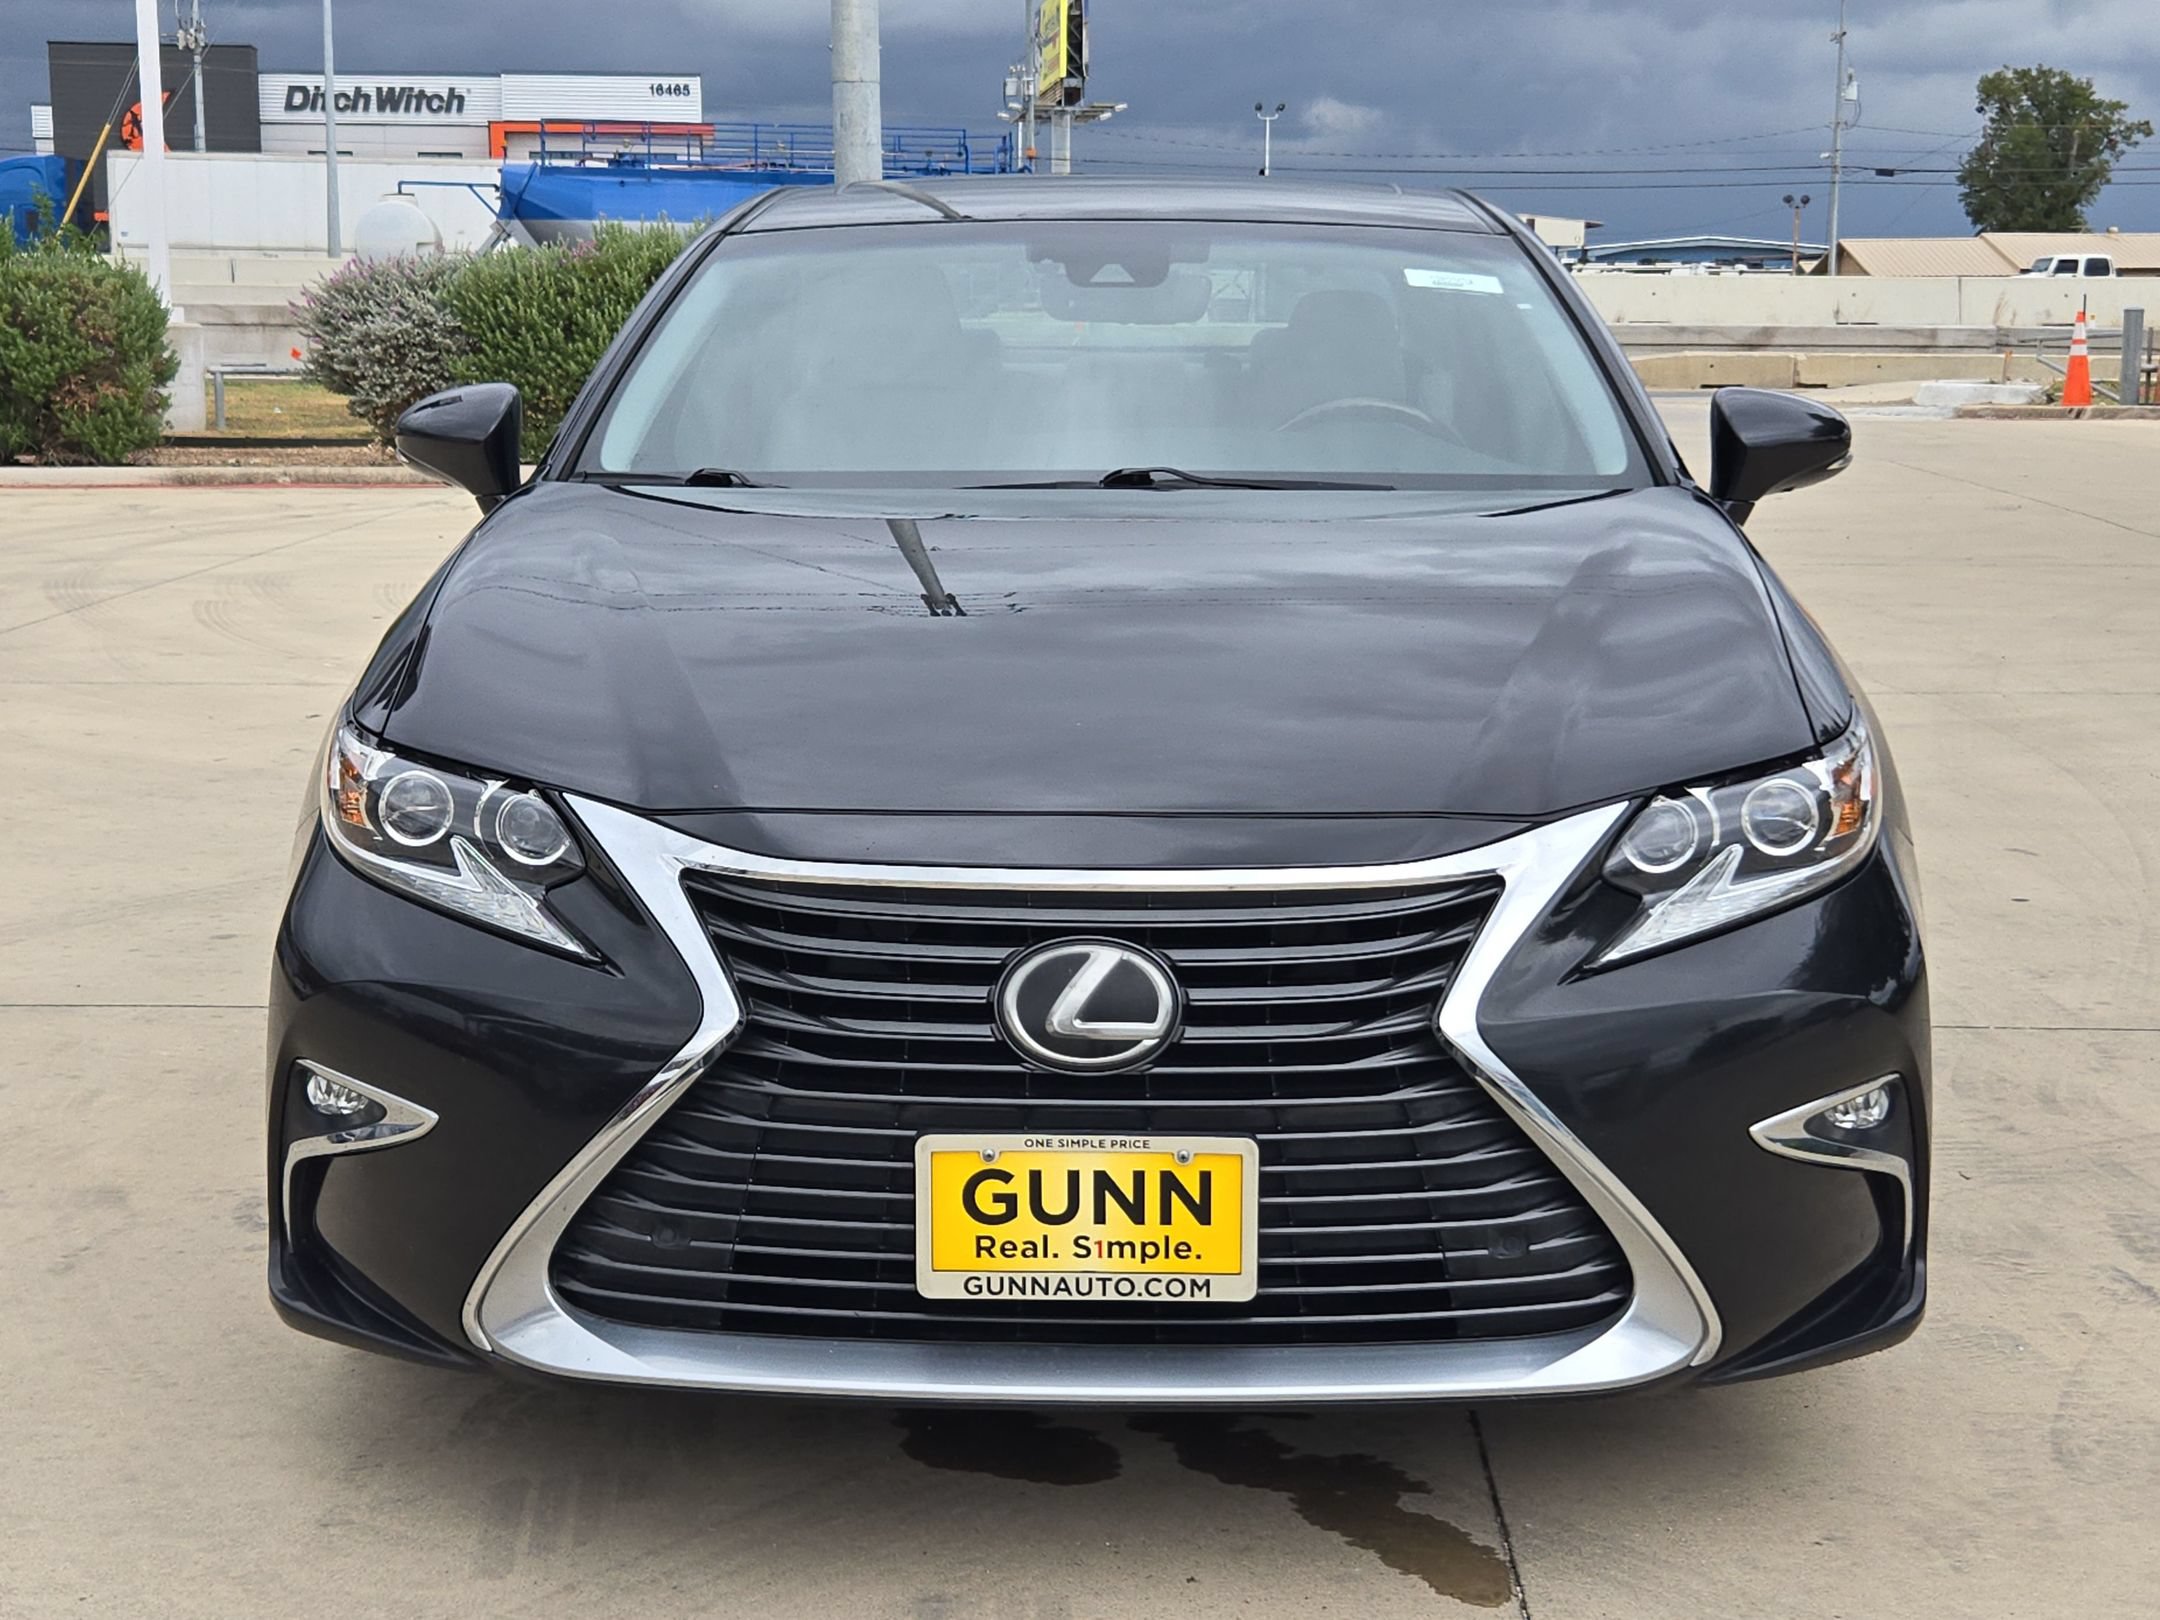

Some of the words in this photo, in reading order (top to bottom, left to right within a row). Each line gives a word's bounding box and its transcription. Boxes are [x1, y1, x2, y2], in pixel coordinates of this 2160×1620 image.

[375, 86, 465, 113] Witch
[649, 83, 690, 96] 16465
[1024, 1138, 1053, 1148] ONE
[1058, 1138, 1106, 1149] SIMPLE
[1110, 1139, 1151, 1149] PRICE
[962, 1168, 1212, 1226] GUNN
[975, 1234, 1059, 1259] Real.
[963, 1275, 1211, 1298] GUNNAUTO.COM
